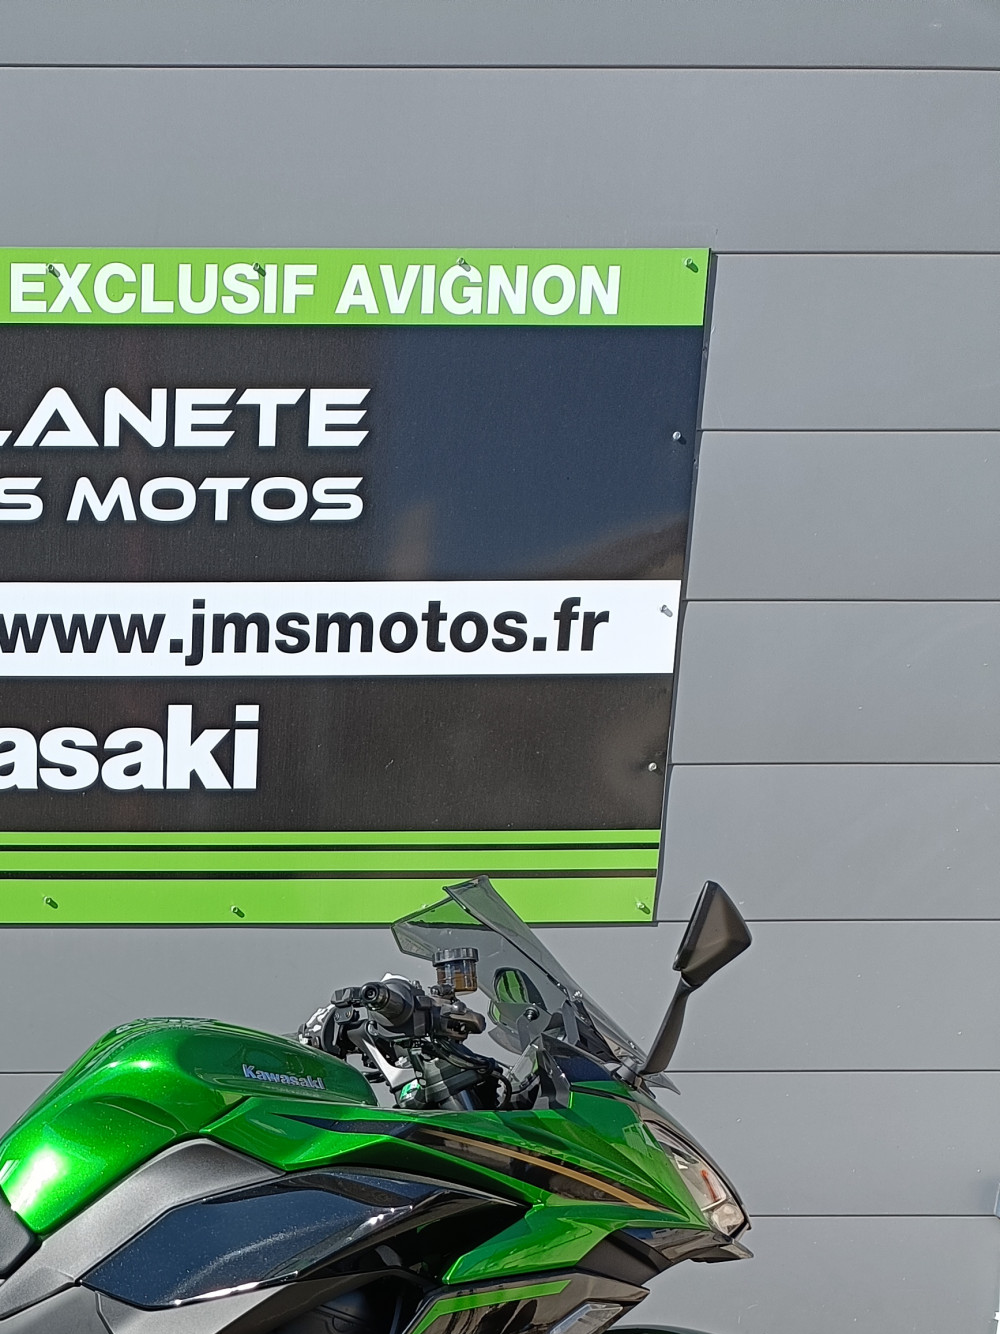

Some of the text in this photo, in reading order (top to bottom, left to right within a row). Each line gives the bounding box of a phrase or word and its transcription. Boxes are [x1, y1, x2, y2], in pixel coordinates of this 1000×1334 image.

[10, 262, 318, 315] EXCLUSIF
[334, 264, 621, 316] AVIGNON
[66, 476, 364, 522] MOTOS
[242, 1063, 325, 1090] Kawasaki
